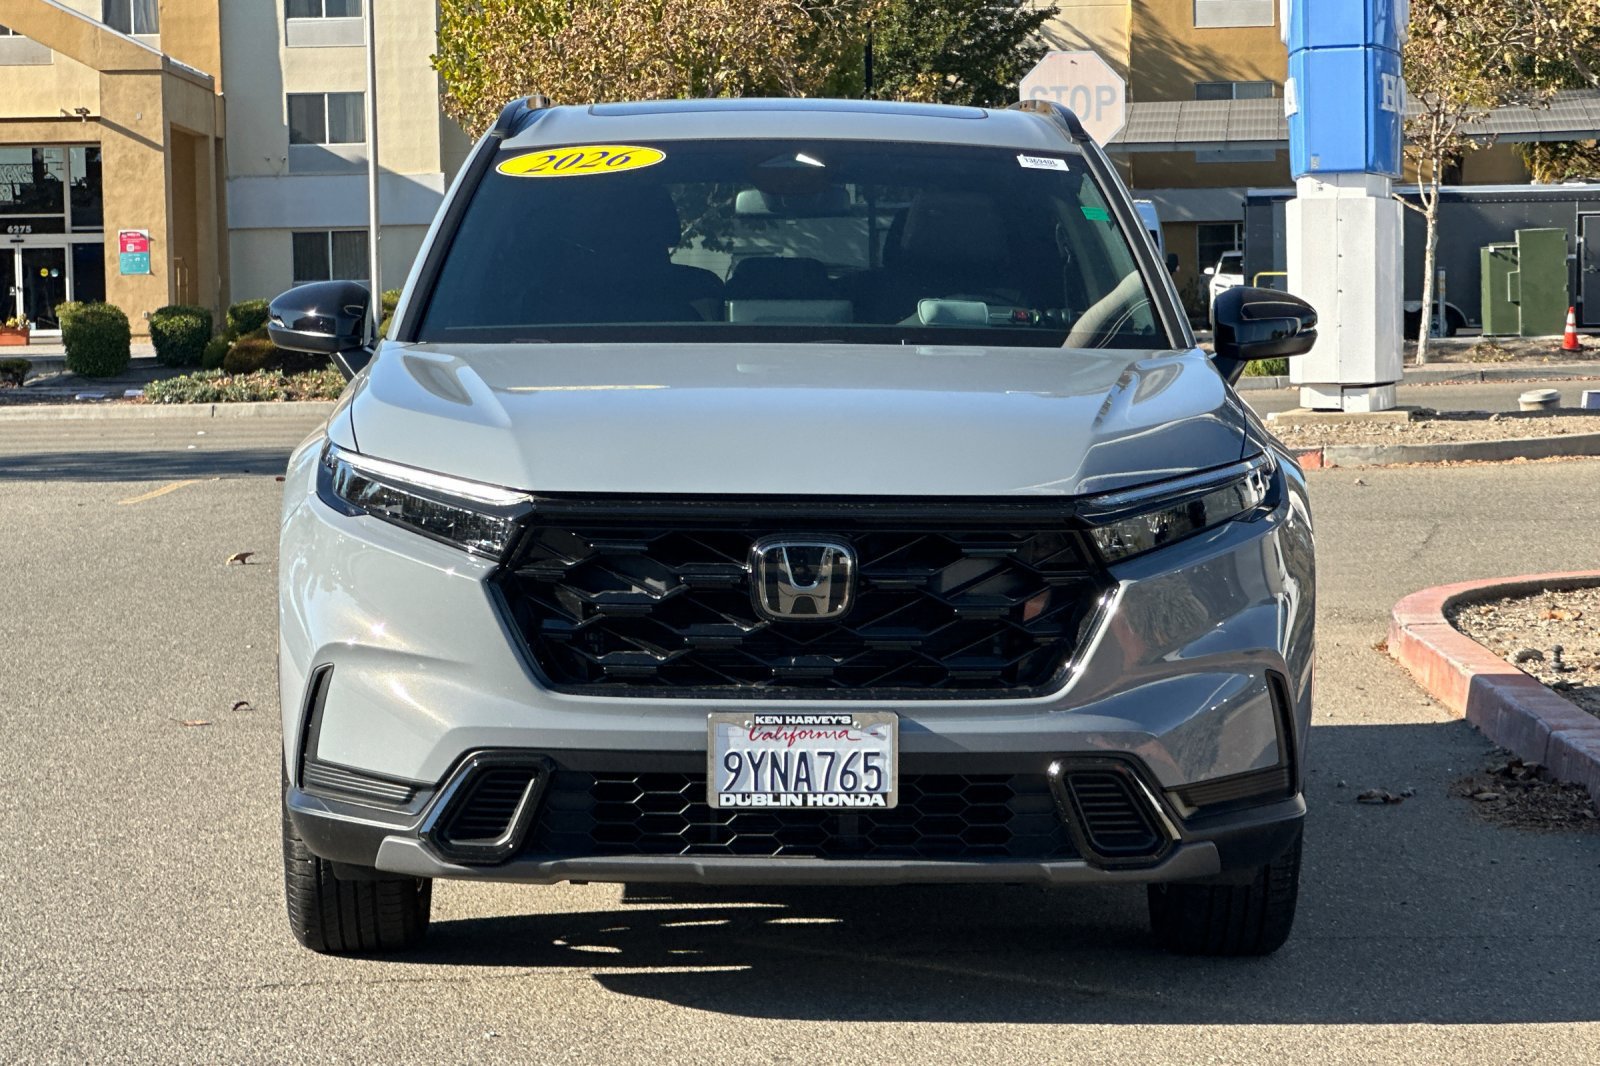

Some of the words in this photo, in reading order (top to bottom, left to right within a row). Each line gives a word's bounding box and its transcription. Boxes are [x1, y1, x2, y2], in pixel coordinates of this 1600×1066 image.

[522, 151, 642, 174] 2026
[7, 225, 32, 234] 6275
[755, 715, 783, 724] KEN
[786, 715, 851, 724] HARVEY'S
[749, 726, 861, 748] California
[724, 751, 882, 791] 9YNA765
[719, 793, 803, 807] DUBLIN
[807, 793, 886, 807] HONDA
